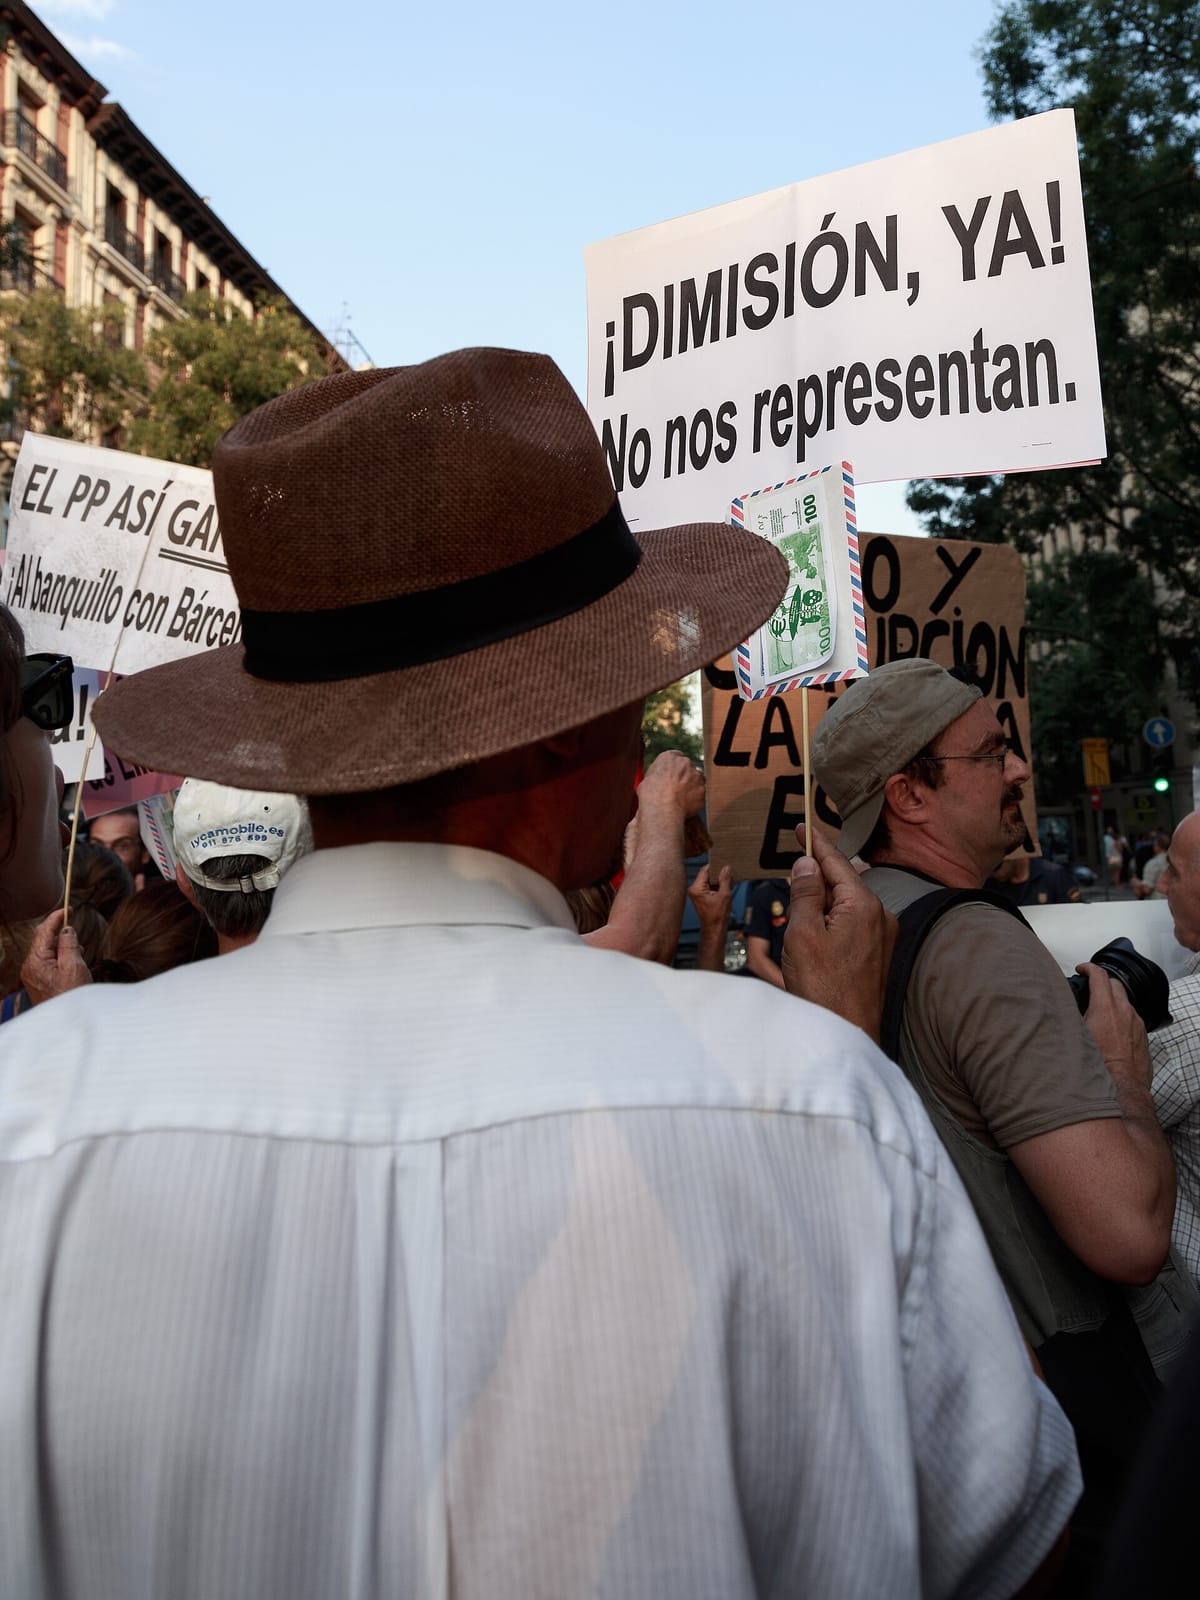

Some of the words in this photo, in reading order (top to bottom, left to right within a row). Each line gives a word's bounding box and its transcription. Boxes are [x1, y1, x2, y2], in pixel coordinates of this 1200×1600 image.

[604, 212, 920, 398] ¡DIMISIÓN,
[940, 180, 1066, 282] YA!
[601, 413, 651, 493] No
[663, 401, 738, 480] nos
[753, 328, 1077, 464] representan.
[20, 464, 58, 515] EL
[62, 474, 111, 522] PP
[104, 479, 174, 537] ASÍ
[168, 500, 222, 553] GA
[803, 494, 818, 524] 100
[30, 555, 124, 631] banquillo
[122, 588, 169, 634] con
[929, 545, 982, 614] Y
[713, 694, 802, 768] LA
[190, 823, 284, 849] lycamobile.es
